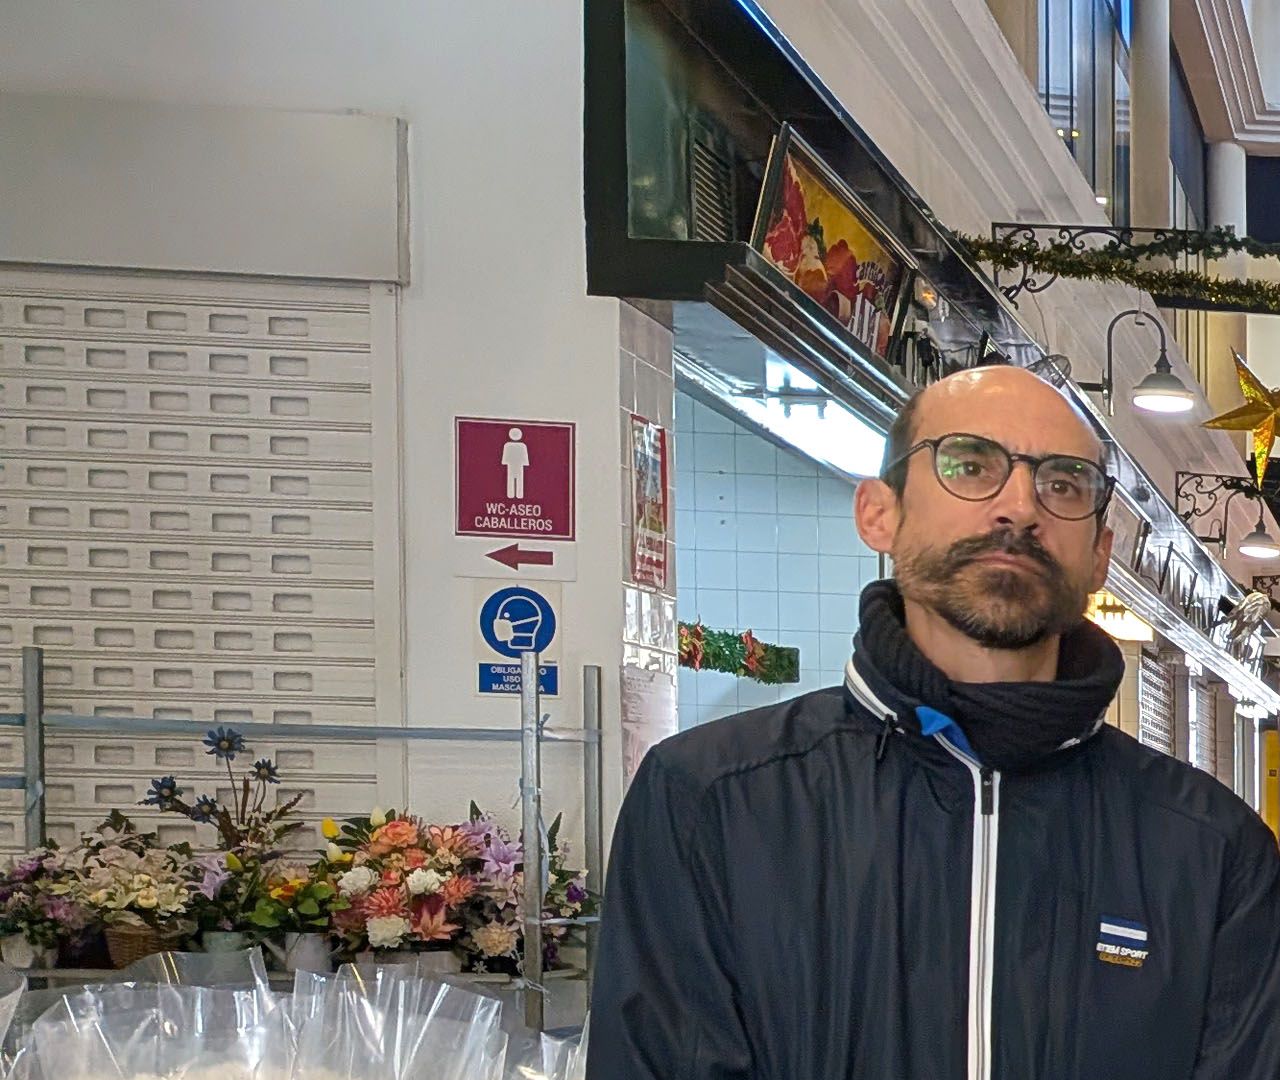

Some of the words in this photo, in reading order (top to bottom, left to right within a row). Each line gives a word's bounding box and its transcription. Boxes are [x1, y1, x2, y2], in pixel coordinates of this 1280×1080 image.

[486, 503, 541, 516] WC-ASEO
[474, 517, 553, 531] CABALLEROS
[1120, 947, 1148, 959] SPORT
